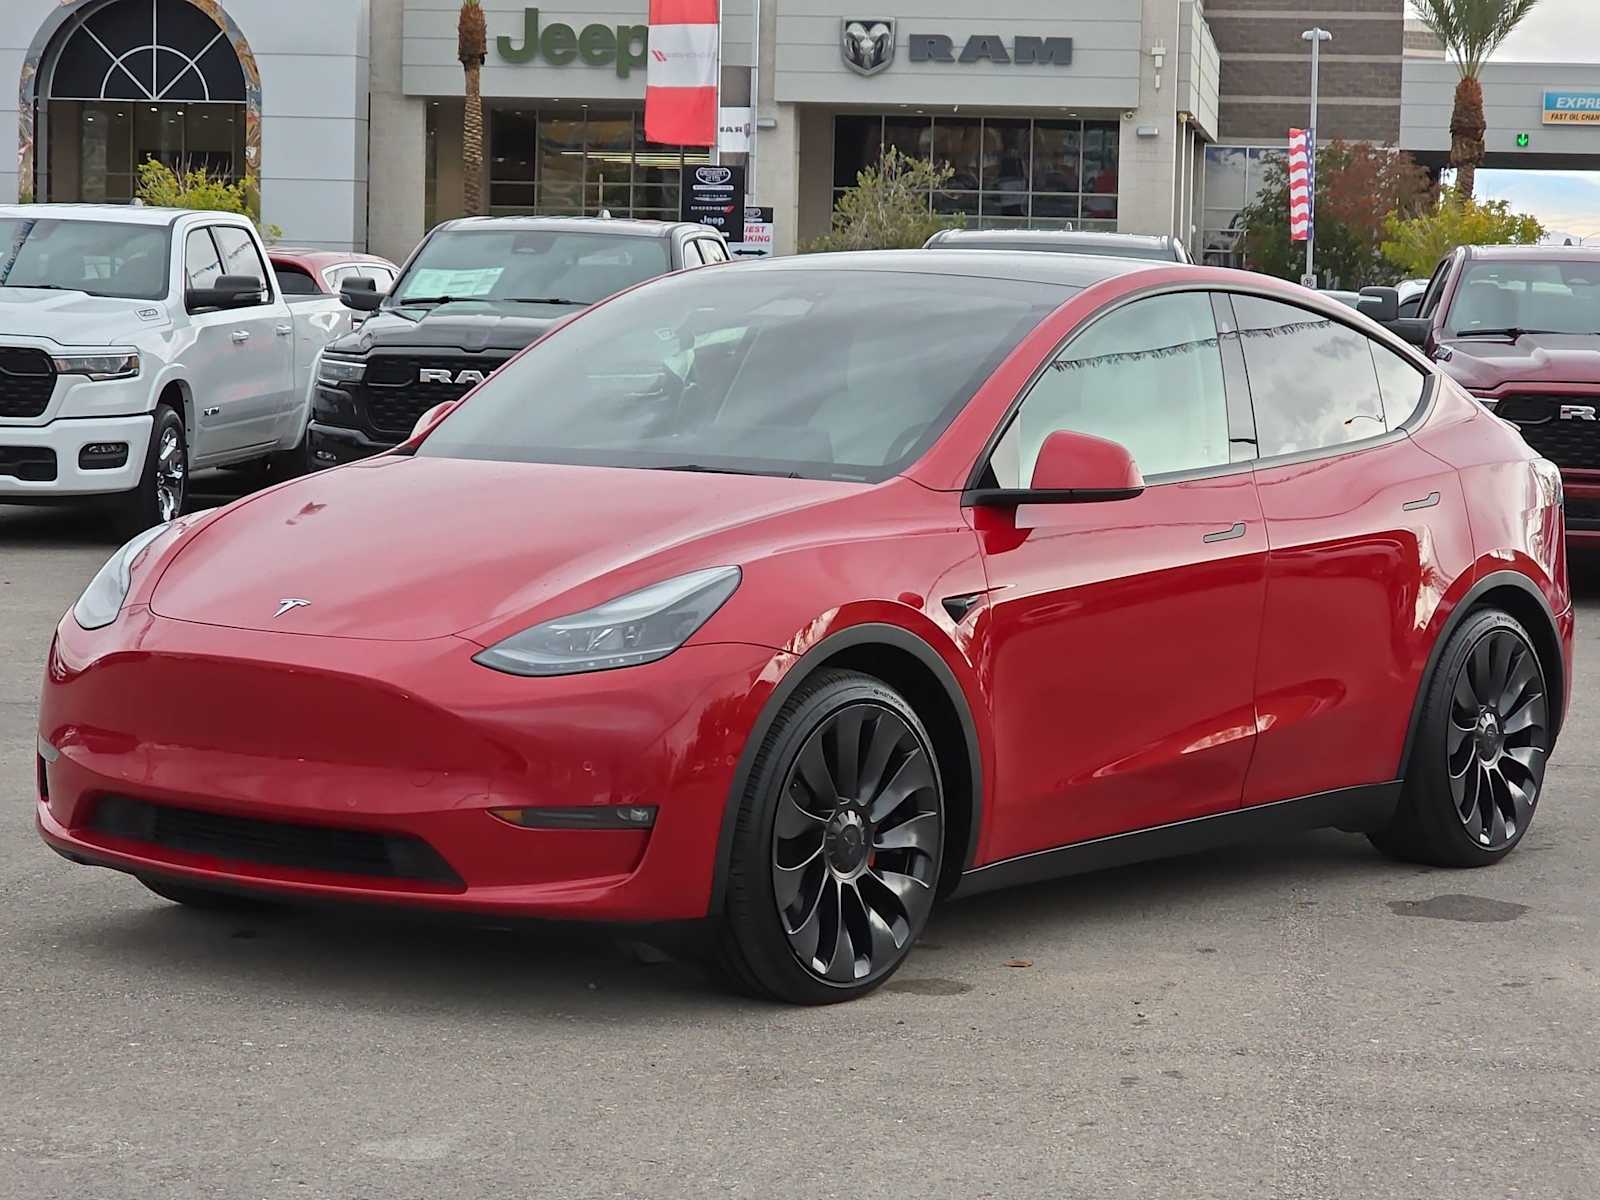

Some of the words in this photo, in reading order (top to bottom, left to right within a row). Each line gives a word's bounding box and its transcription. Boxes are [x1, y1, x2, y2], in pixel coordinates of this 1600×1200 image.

[497, 8, 648, 79] Jeep
[909, 34, 1073, 65] RAM
[1551, 113, 1567, 121] FAST
[1569, 113, 1579, 121] OIL
[700, 215, 725, 226] Jeep
[419, 367, 496, 384] RA
